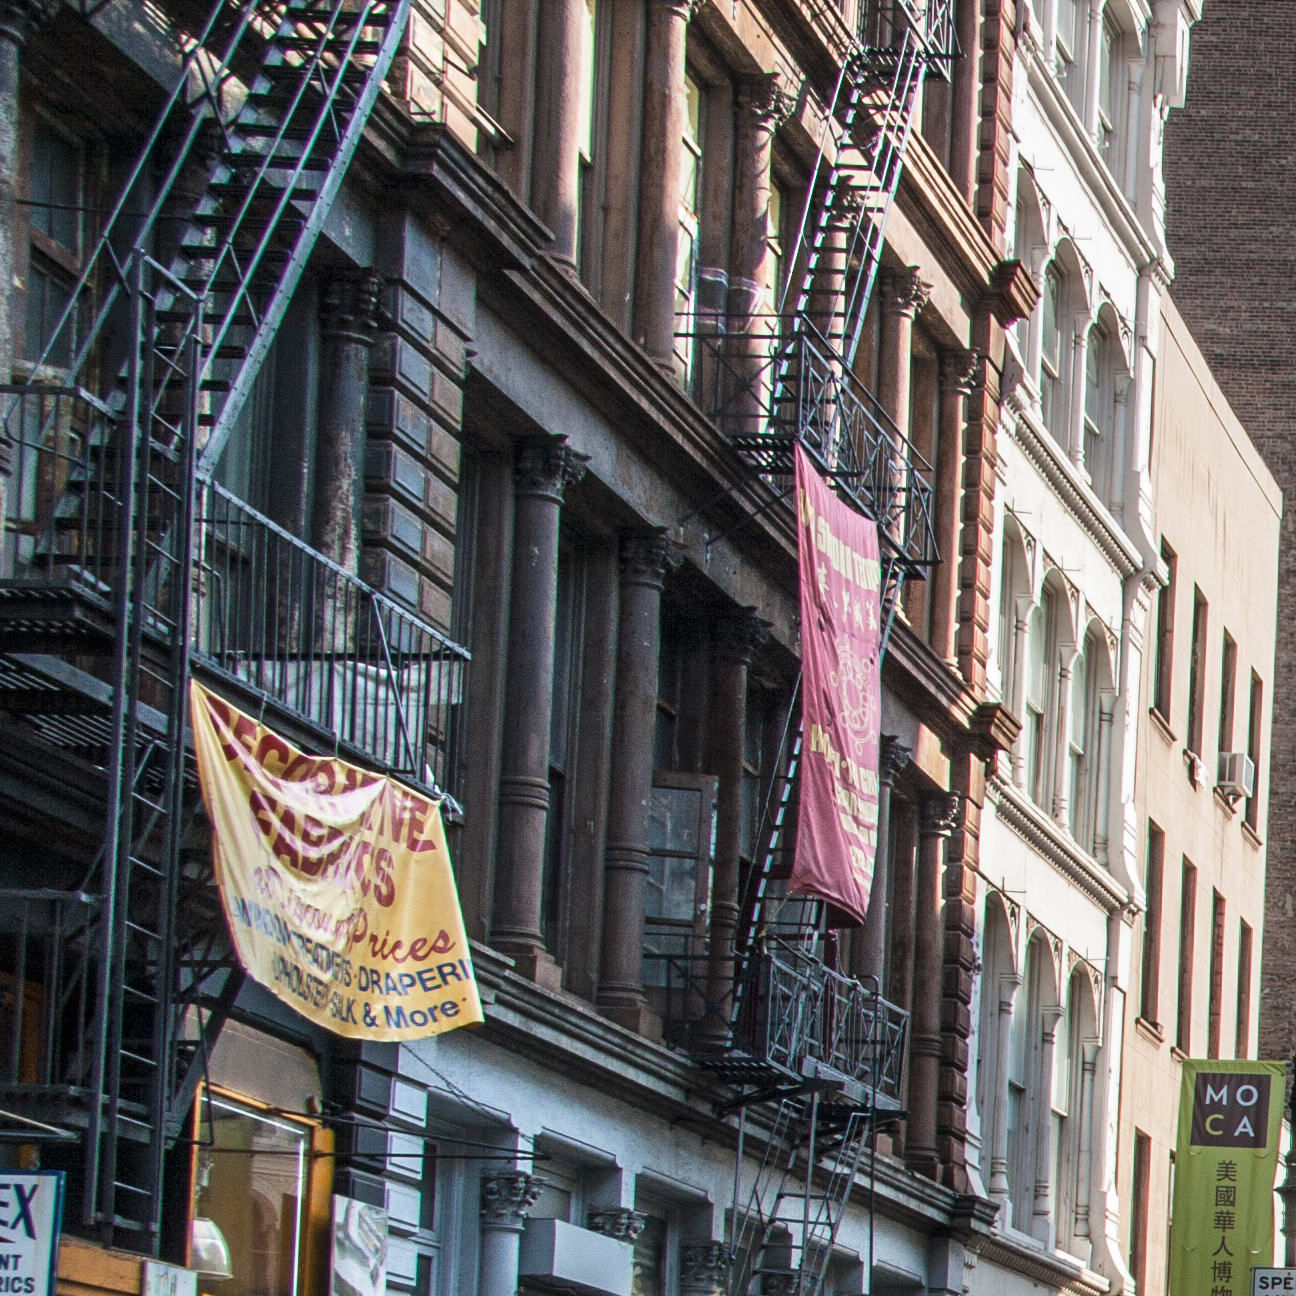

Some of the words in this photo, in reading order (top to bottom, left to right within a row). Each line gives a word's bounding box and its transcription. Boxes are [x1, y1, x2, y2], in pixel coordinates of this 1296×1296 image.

[346, 906, 456, 965] Prices
[363, 1002, 379, 1029] &
[384, 997, 461, 1029] More
